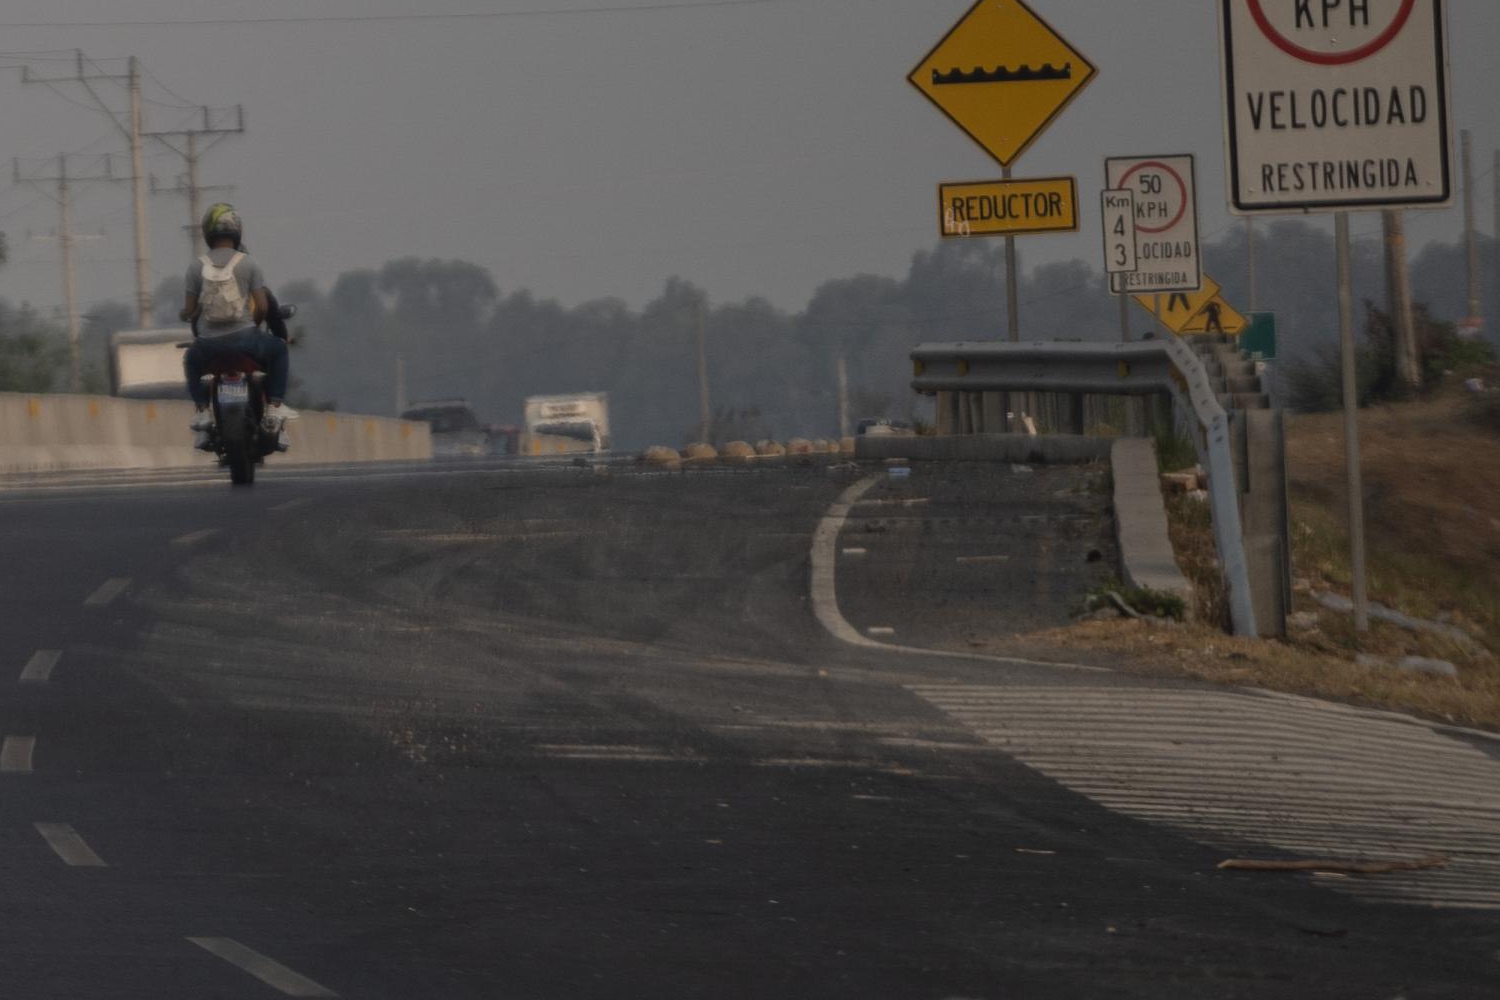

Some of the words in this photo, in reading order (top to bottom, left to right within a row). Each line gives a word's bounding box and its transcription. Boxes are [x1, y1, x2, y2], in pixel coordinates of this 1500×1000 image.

[1247, 84, 1427, 131] VELOCIDAD
[1139, 174, 1162, 195] 50
[1261, 157, 1419, 193] RESTRINGIDA
[951, 191, 1063, 222] REDUCTOR
[1105, 195, 1130, 209] Km
[1136, 200, 1168, 219] KPH
[1113, 214, 1125, 237] 4
[1115, 243, 1127, 266] 3
